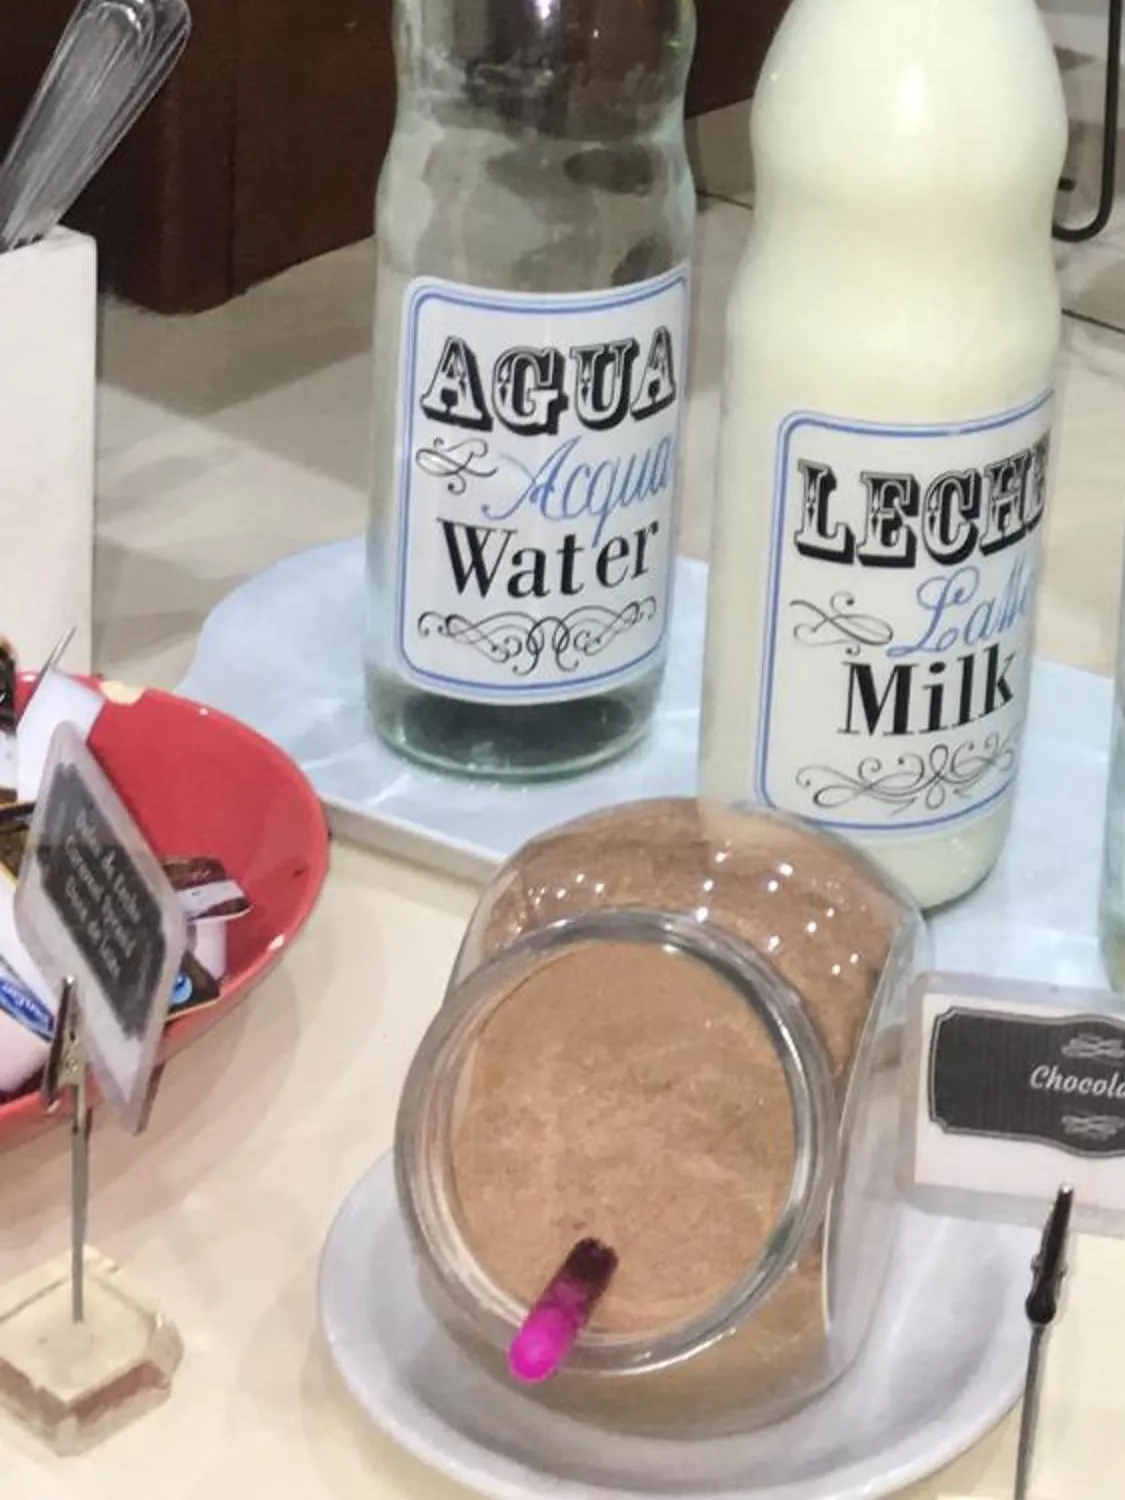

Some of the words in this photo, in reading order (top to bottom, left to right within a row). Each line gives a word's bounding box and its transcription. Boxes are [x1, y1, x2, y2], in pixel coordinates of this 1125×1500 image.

[419, 324, 676, 436] AGUA
[480, 434, 675, 548] Acqua
[437, 516, 660, 600] Water
[838, 643, 1017, 738] Milk
